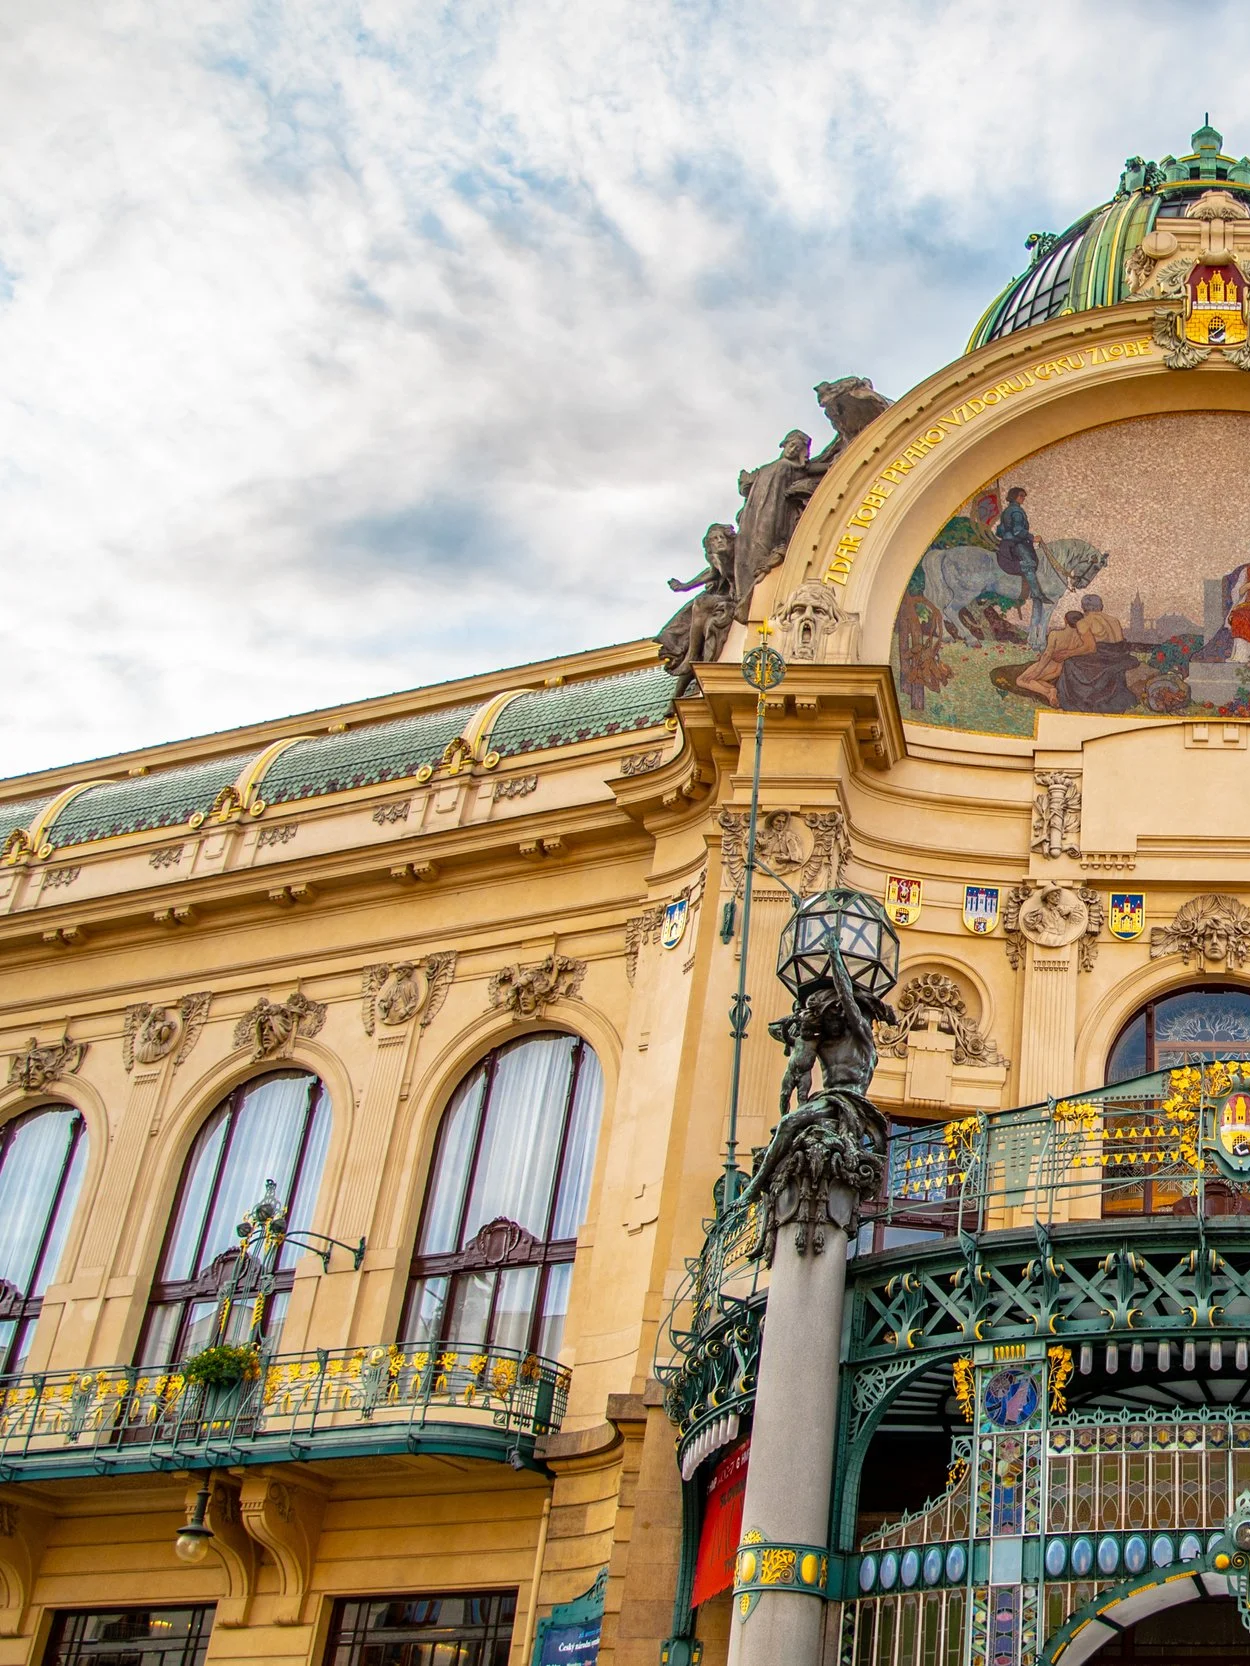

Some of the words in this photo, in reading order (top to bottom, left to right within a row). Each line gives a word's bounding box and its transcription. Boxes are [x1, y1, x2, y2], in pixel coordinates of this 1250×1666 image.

[822, 533, 863, 586] ZDAR
[846, 477, 894, 529] TOBĚ
[880, 422, 951, 485] PRAHO!
[940, 371, 1036, 427] VZDORUJ
[1031, 353, 1085, 380] ČASU
[1085, 335, 1153, 365] ZLOBĚ
